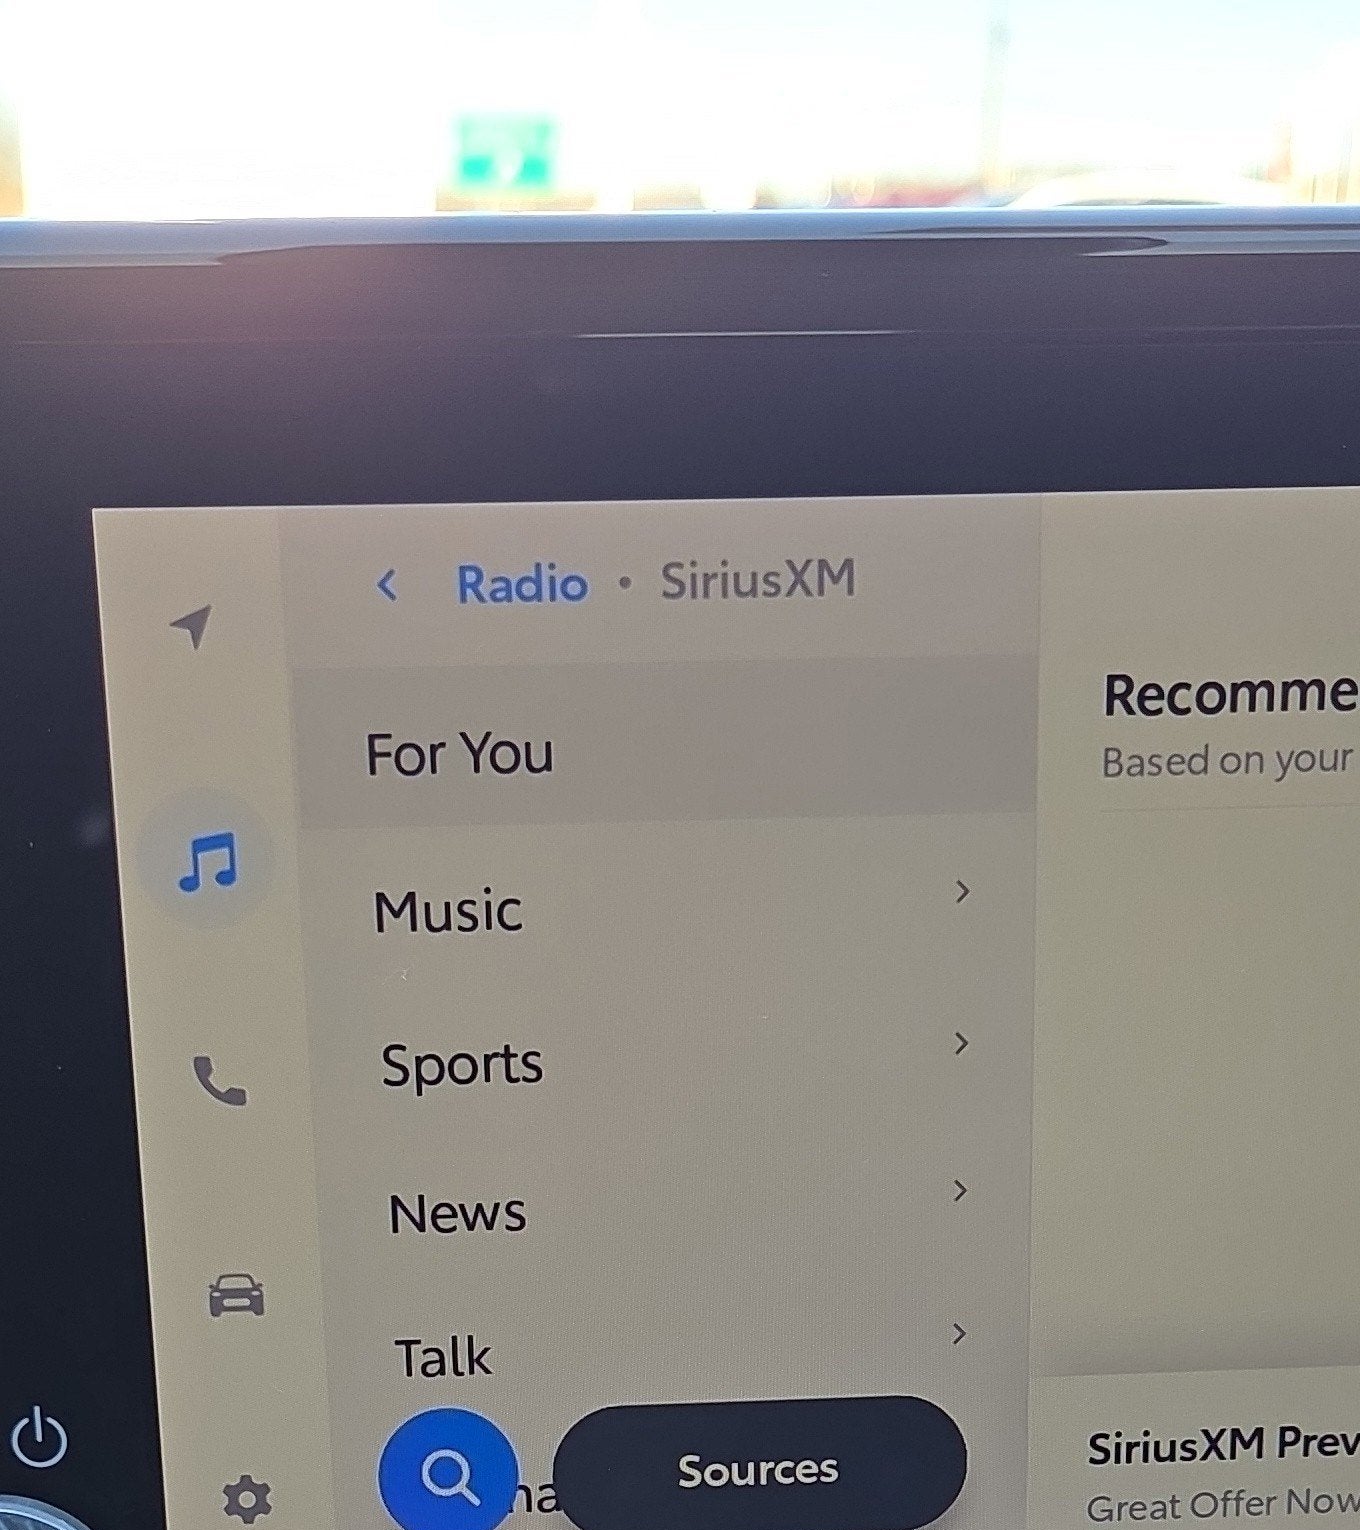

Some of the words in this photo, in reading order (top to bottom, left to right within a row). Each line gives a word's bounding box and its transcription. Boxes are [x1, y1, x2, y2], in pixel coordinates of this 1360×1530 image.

[458, 561, 588, 604] Radio
[661, 557, 855, 600] SiriusXM
[367, 733, 447, 777] For
[458, 731, 553, 775] You
[1103, 743, 1210, 778] Based
[1219, 751, 1265, 775] on
[1274, 748, 1355, 783] your
[375, 886, 523, 933] Music
[382, 1043, 543, 1097] Sports
[390, 1194, 526, 1234] News
[394, 1334, 492, 1378] Talk
[1088, 1426, 1264, 1465] SiriusXM
[678, 1454, 839, 1488] Sources
[1087, 1494, 1182, 1523] Great
[1190, 1488, 1278, 1519] Offer
